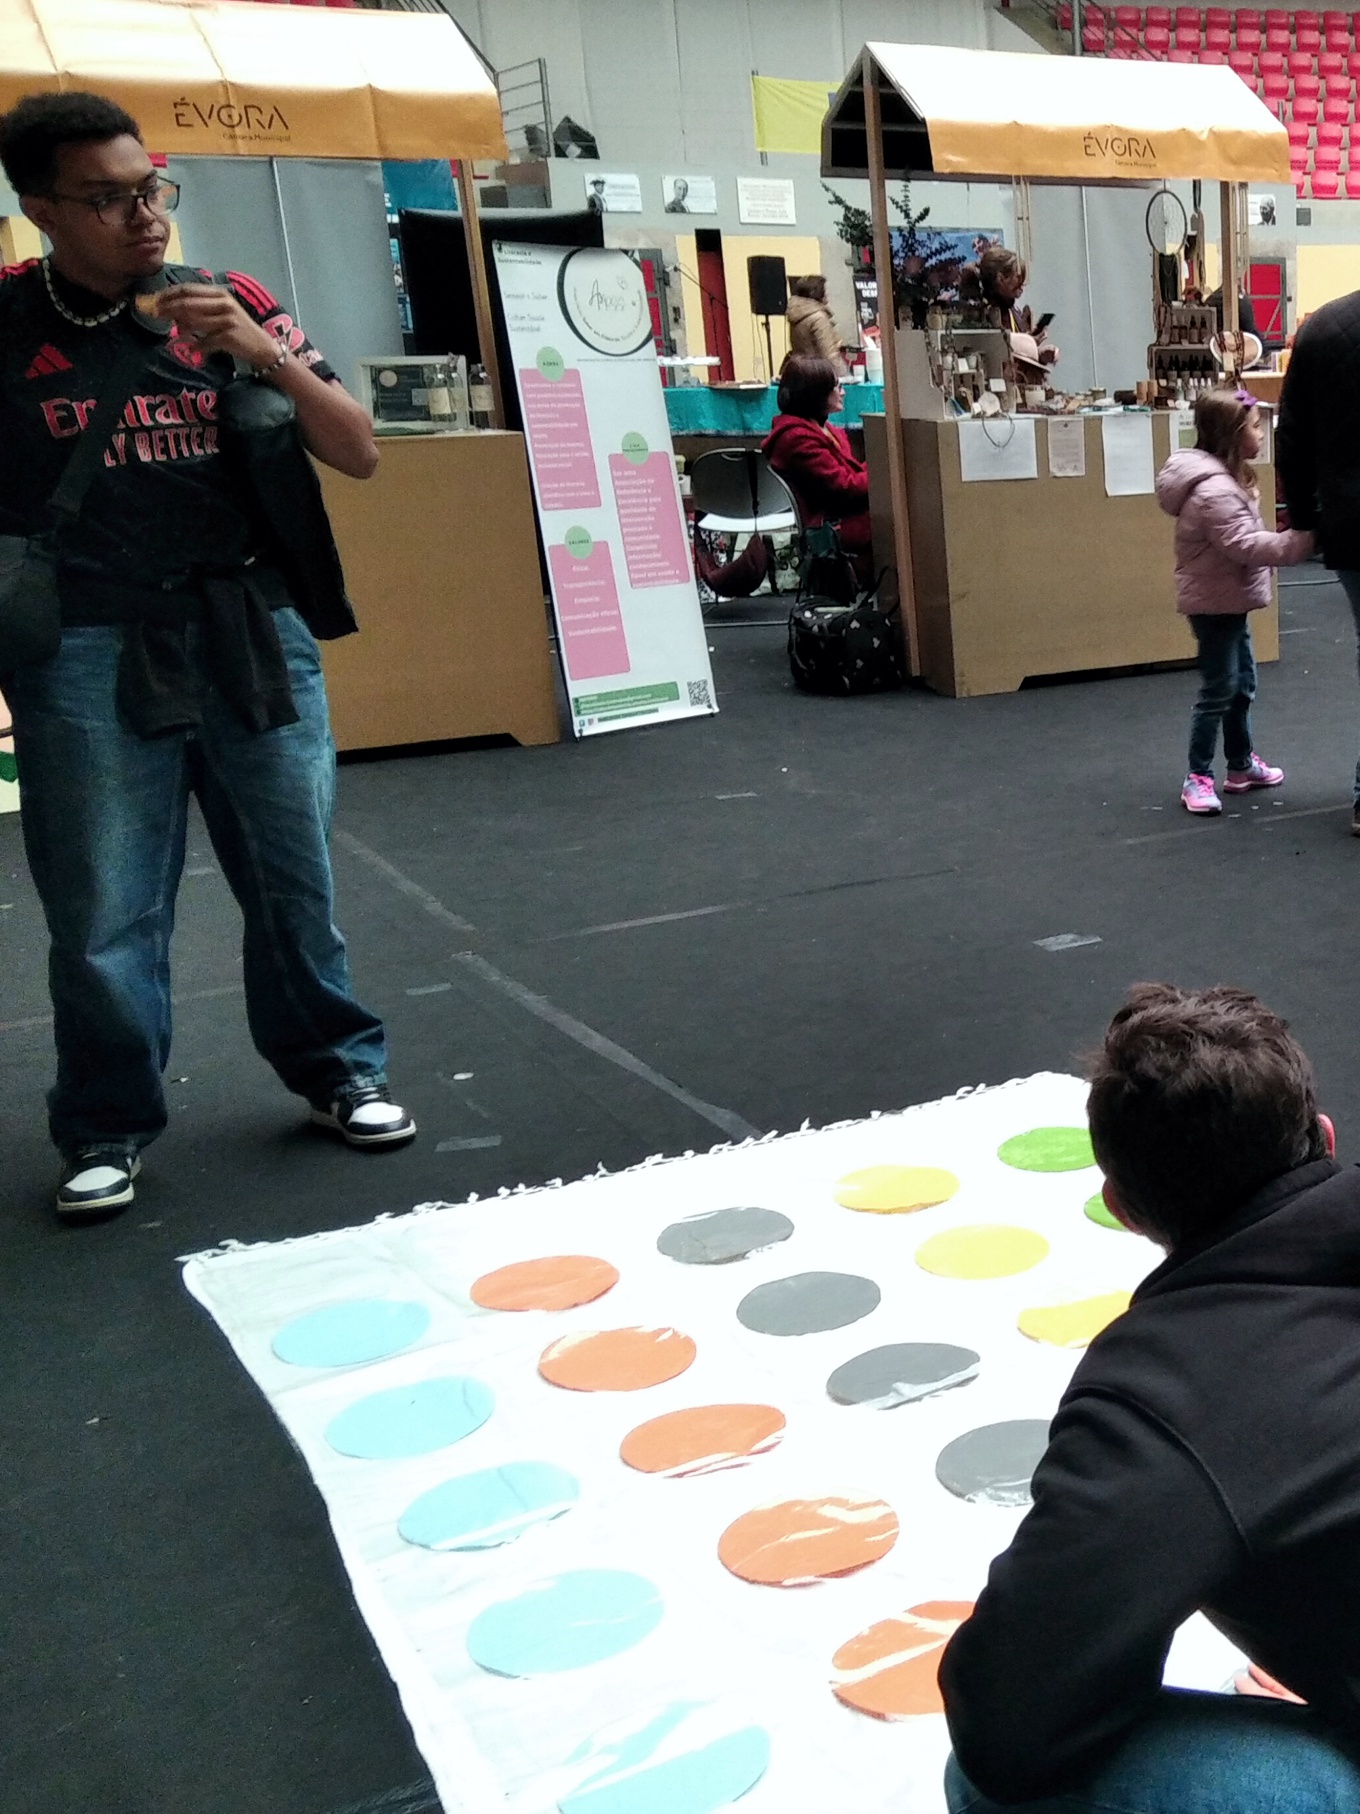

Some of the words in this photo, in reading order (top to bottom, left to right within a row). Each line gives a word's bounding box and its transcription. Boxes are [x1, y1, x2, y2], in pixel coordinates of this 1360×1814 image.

[173, 97, 289, 130] ÉVORA
[1083, 131, 1156, 158] ÉVORA
[40, 388, 218, 439] Eirate
[103, 433, 126, 467] LY
[134, 426, 220, 463] BETTER
